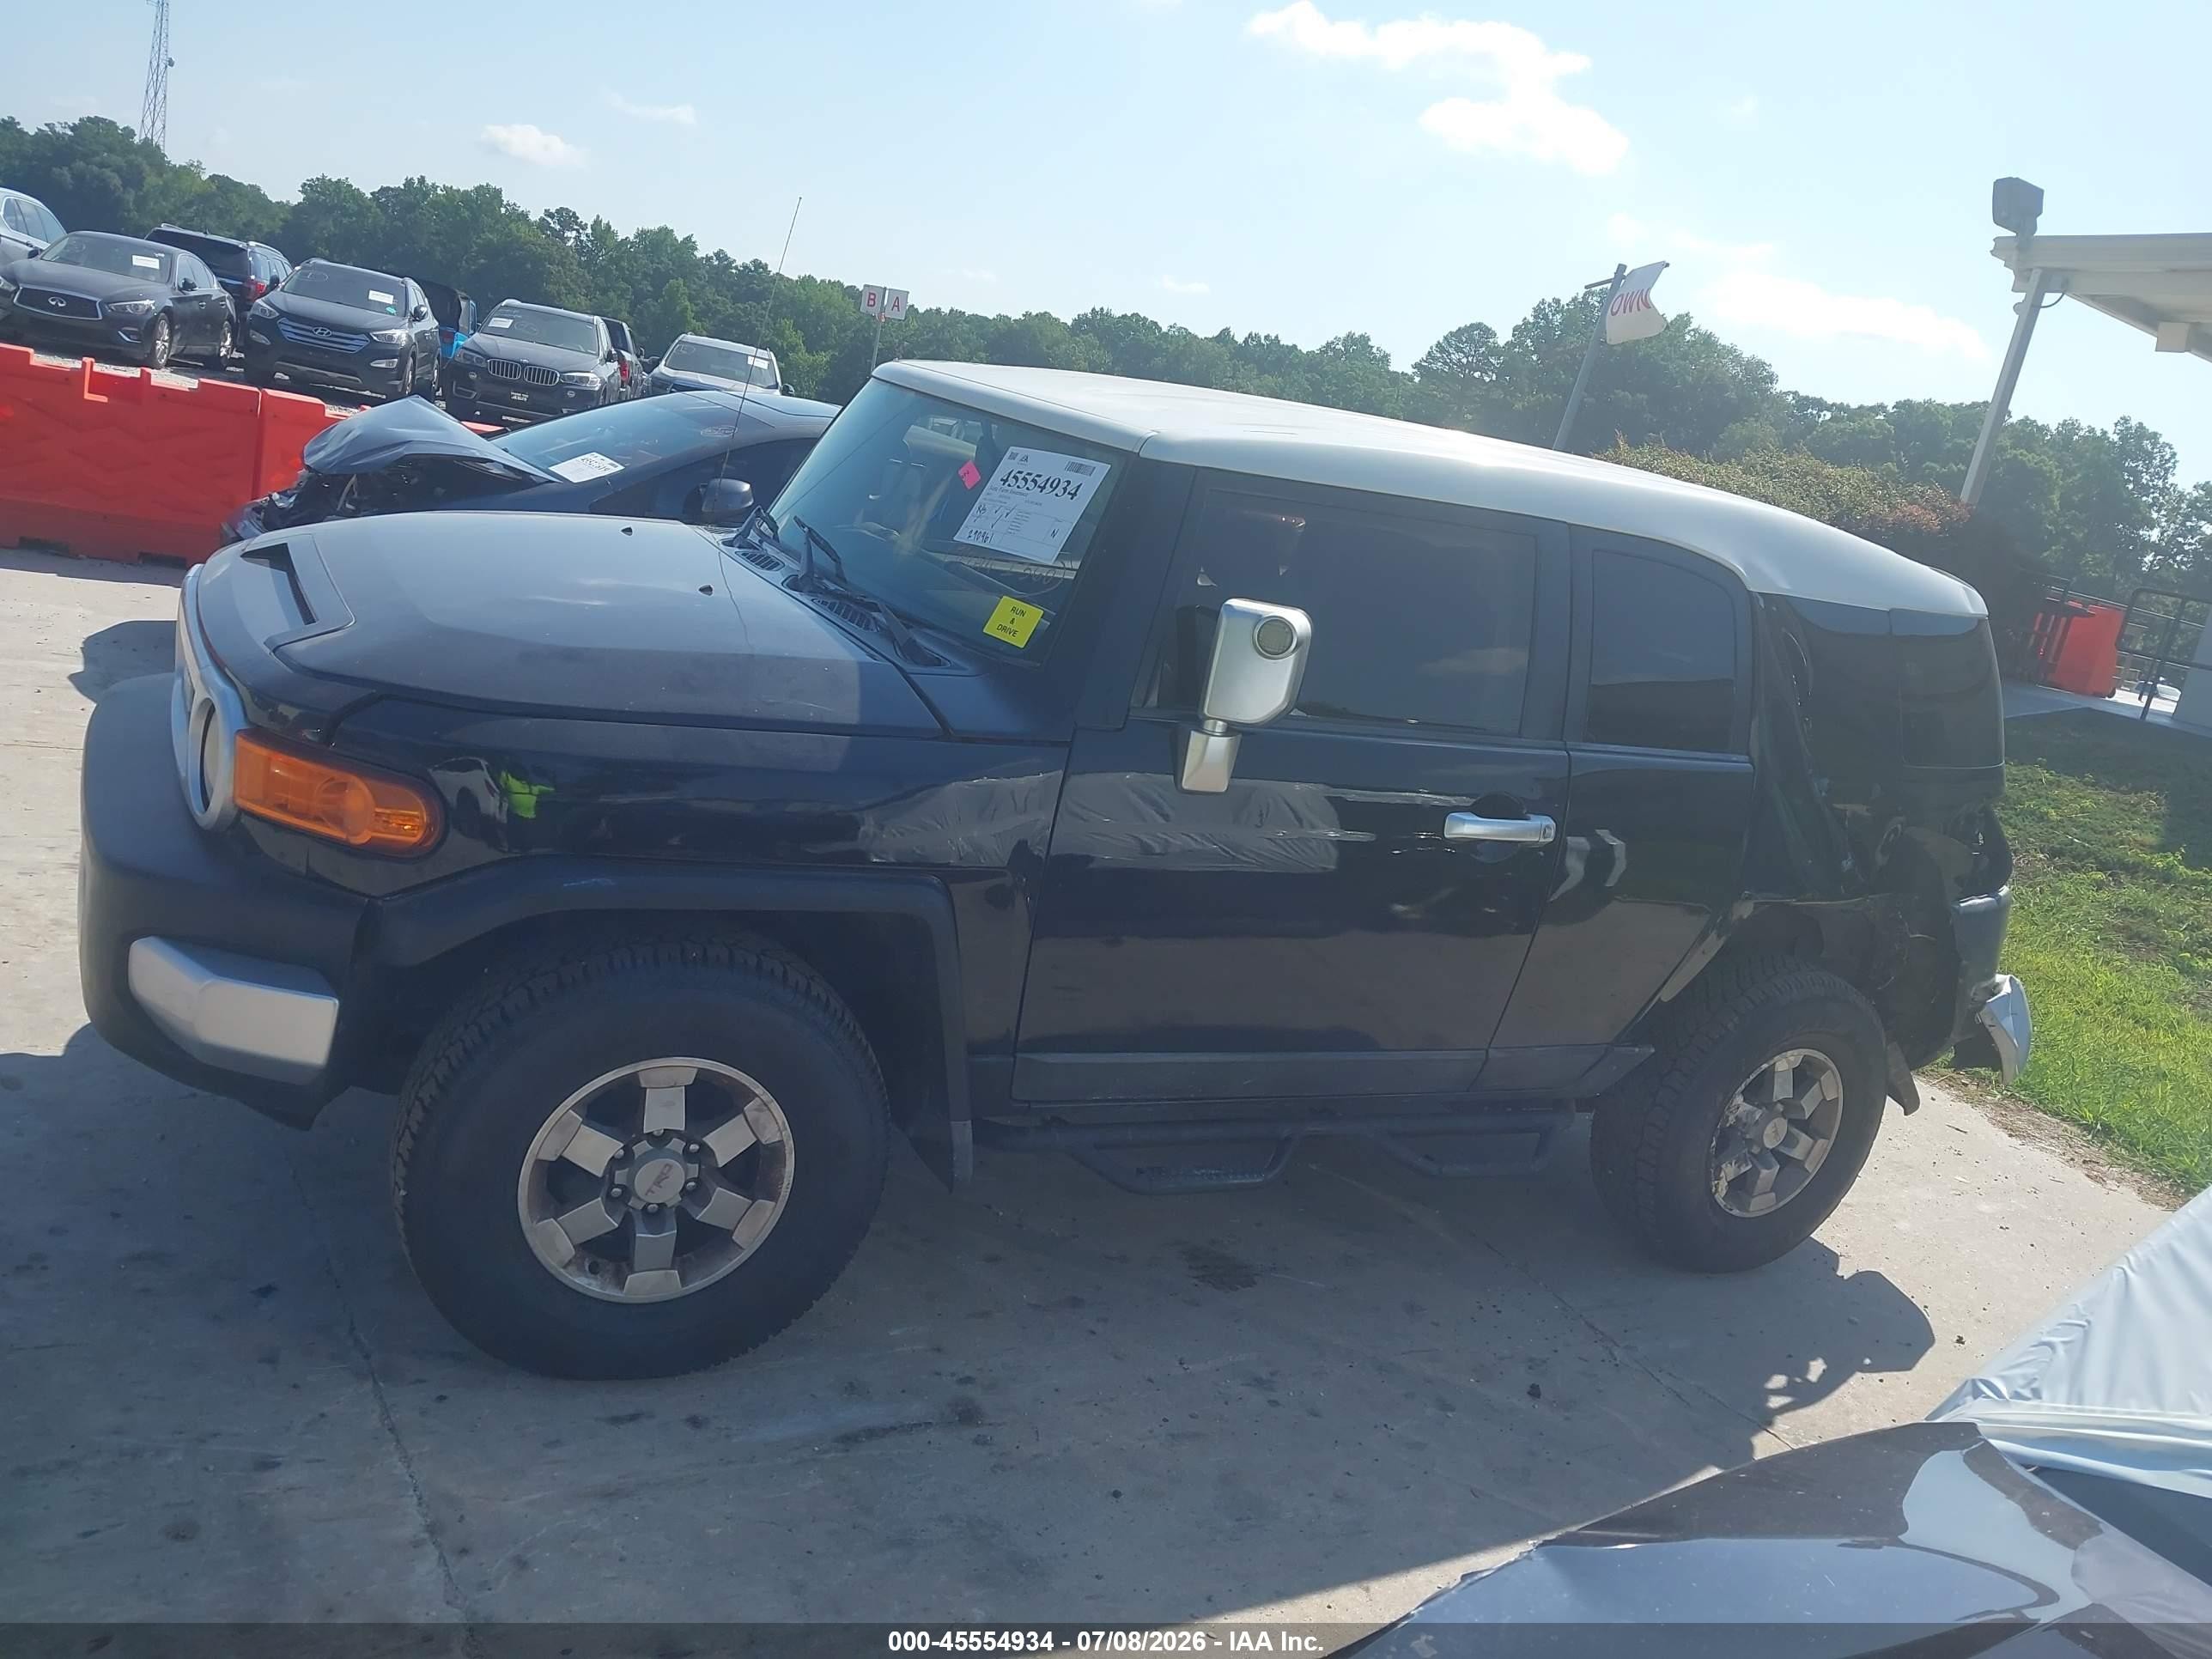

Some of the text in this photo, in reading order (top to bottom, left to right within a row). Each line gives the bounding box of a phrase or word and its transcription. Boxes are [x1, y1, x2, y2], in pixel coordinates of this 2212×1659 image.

[867, 292, 876, 307] B
[891, 296, 900, 312] A
[1000, 468, 1083, 501] 45554934
[1010, 605, 1026, 617] RUN
[996, 623, 1018, 637] DRIVE
